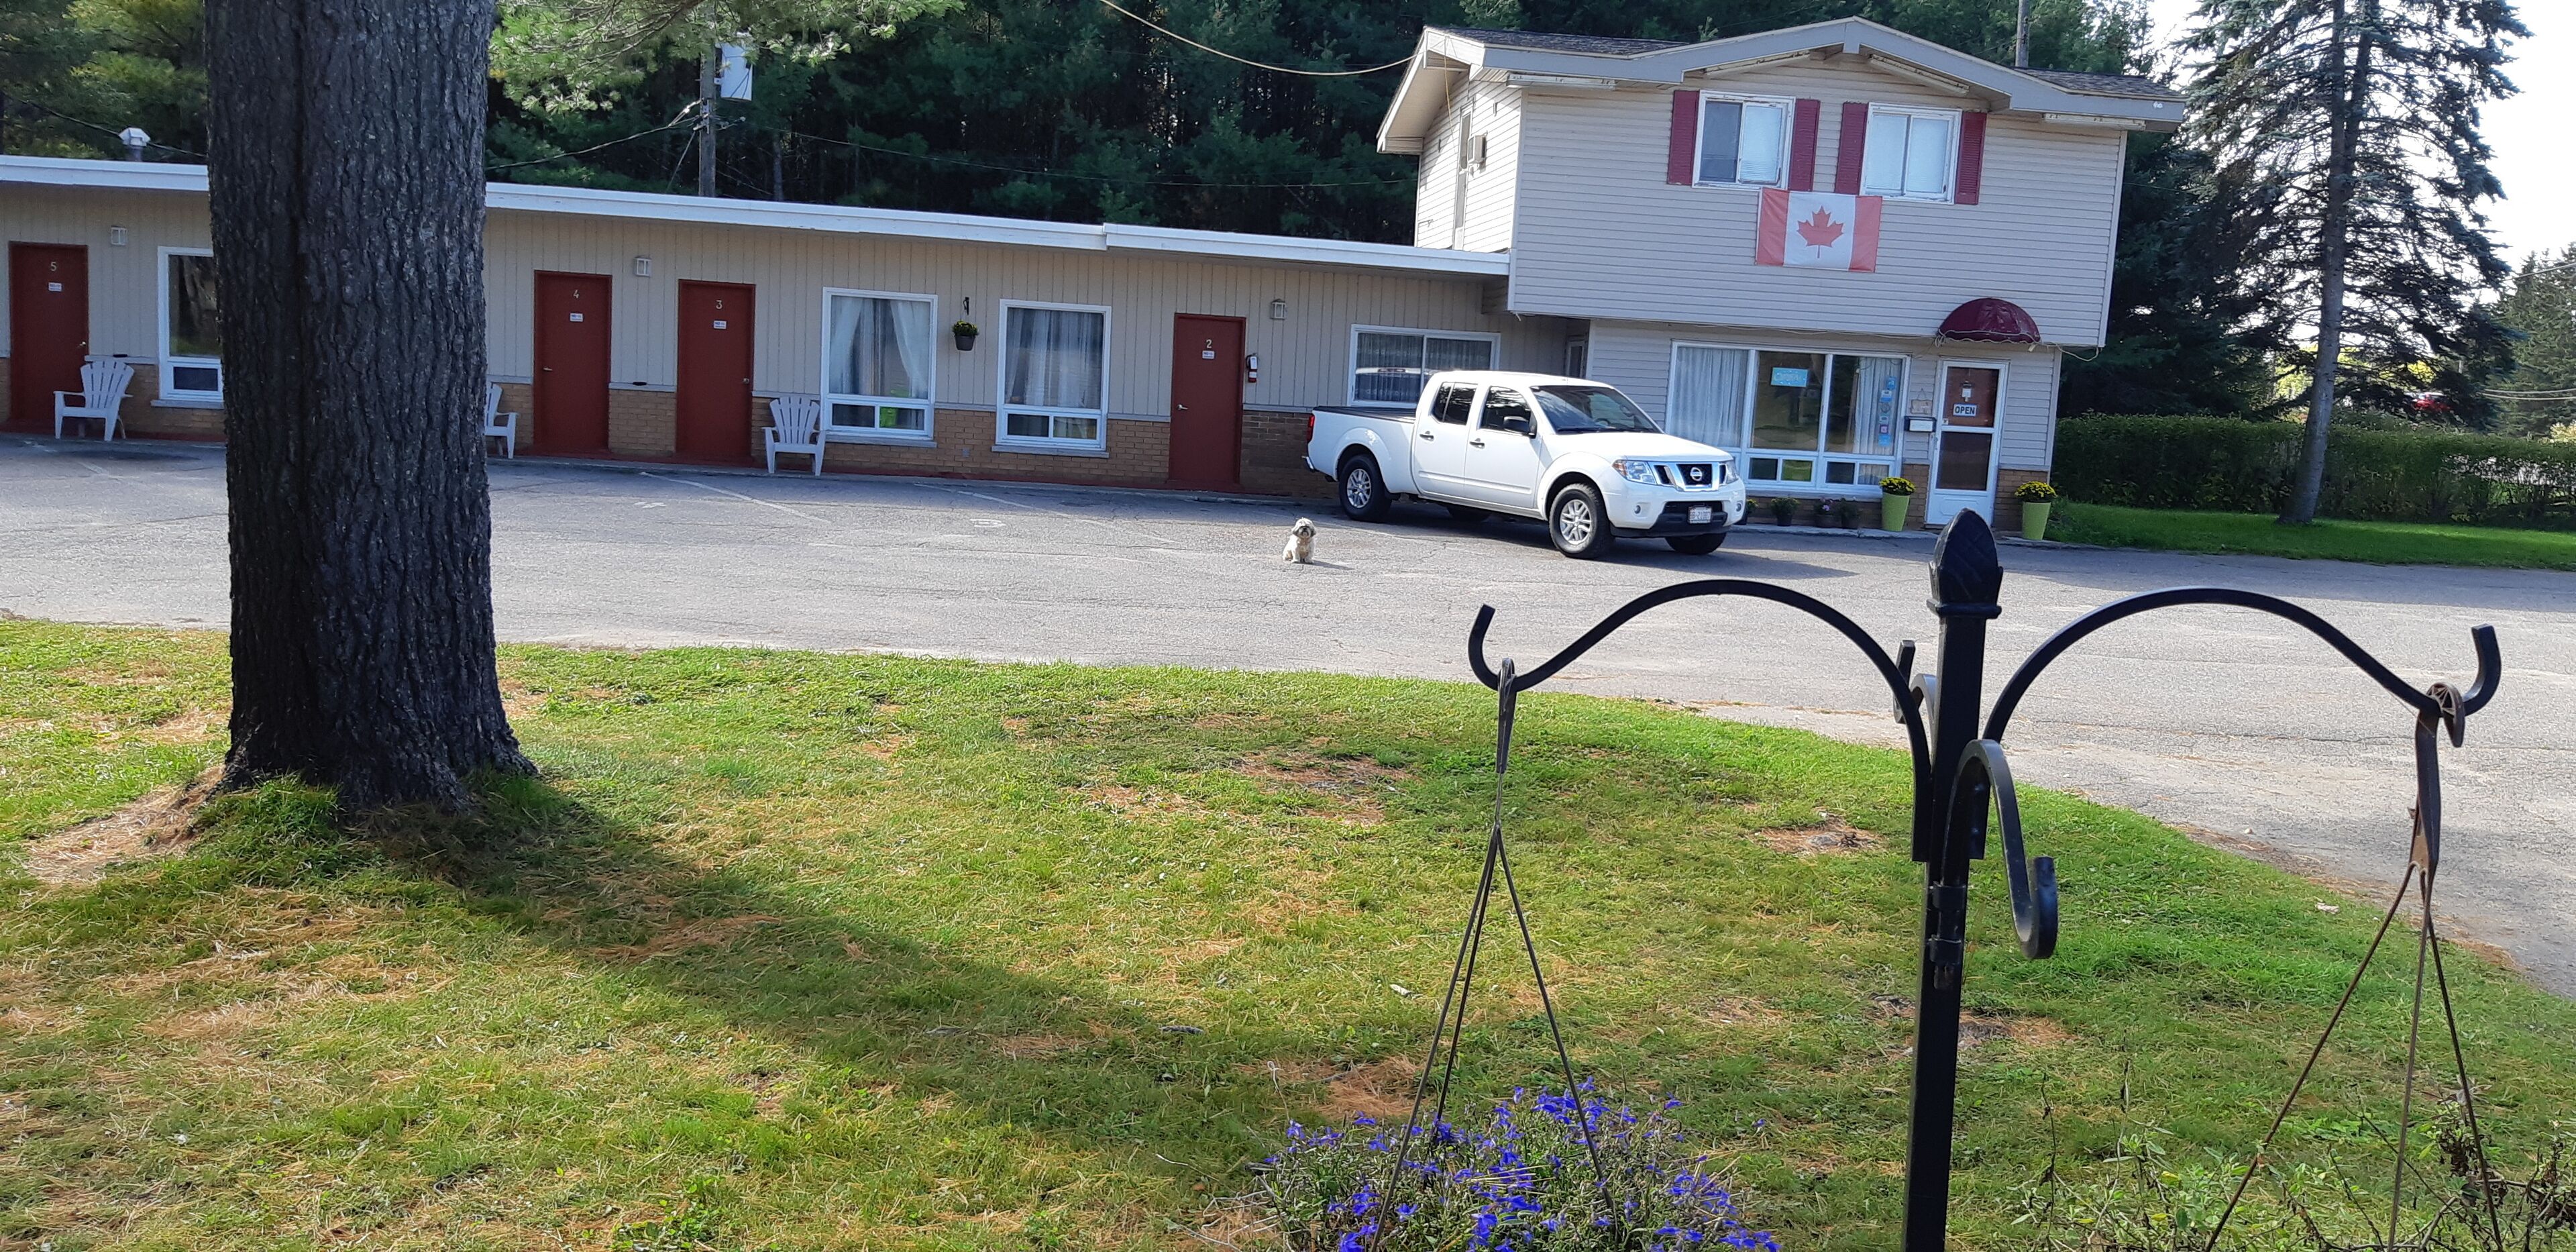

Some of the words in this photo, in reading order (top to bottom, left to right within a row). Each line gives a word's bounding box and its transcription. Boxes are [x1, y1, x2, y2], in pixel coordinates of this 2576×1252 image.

[51, 262, 57, 272] 5
[574, 289, 580, 299] 4
[716, 299, 722, 309] 3
[1206, 339, 1212, 348] 2
[1955, 406, 1976, 415] OPEN
